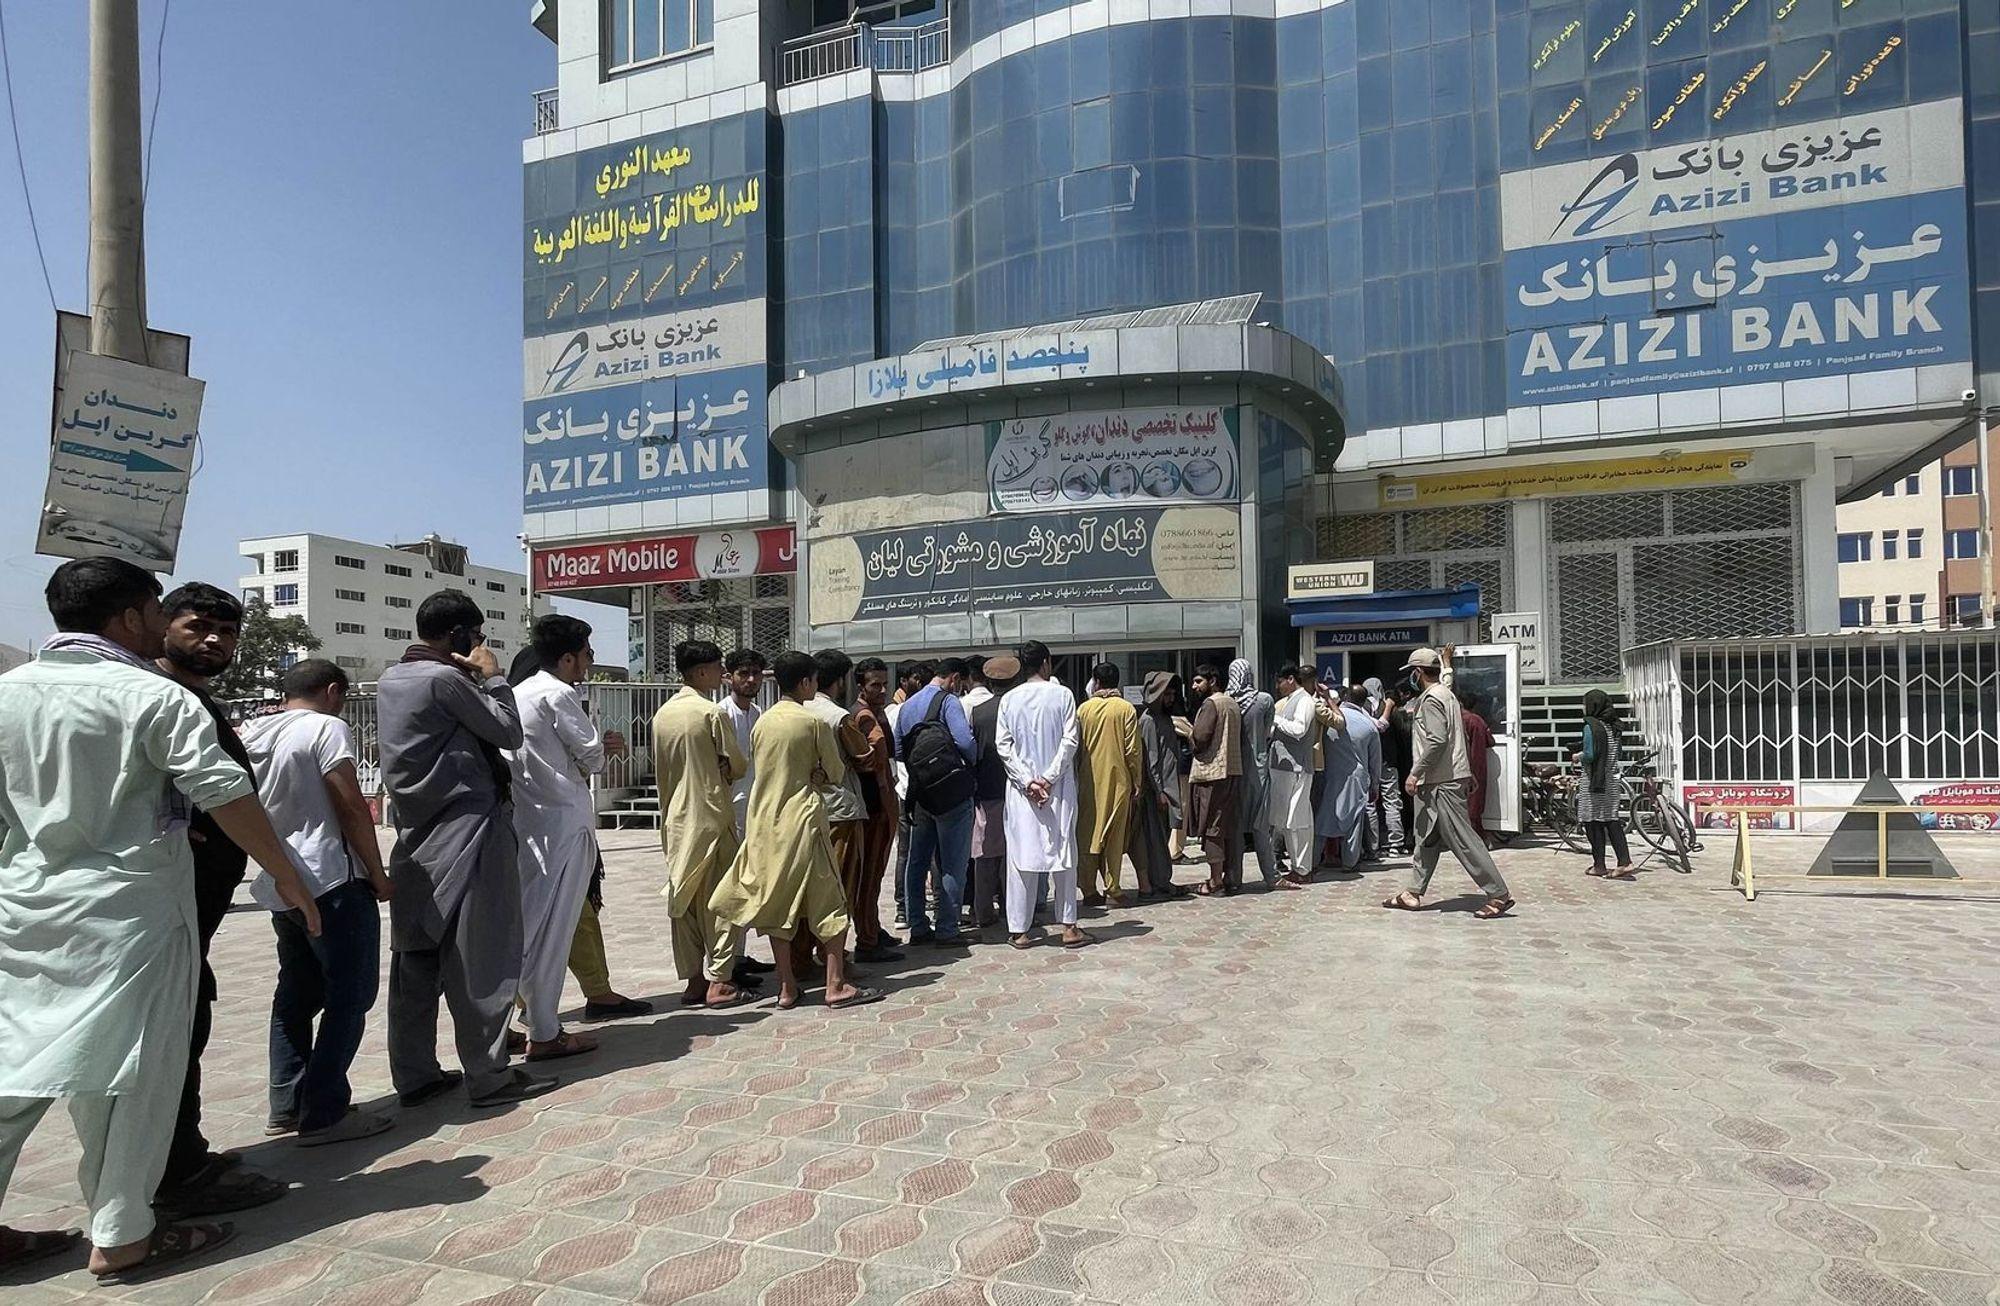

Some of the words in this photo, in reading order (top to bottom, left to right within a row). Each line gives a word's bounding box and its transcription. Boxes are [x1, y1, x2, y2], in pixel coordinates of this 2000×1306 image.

[1675, 72, 1706, 105] طبقات
[1651, 105, 1676, 130] صوت
[651, 144, 692, 176] معهد
[1651, 142, 1745, 183] بانک
[1760, 124, 1883, 175] عزیزی
[595, 143, 648, 199] النوري
[687, 176, 760, 228] للدراسات
[1648, 180, 1751, 218] Azizi
[1767, 163, 1889, 200] Bank
[533, 215, 583, 264] العربية
[584, 206, 628, 250] واللغة
[1693, 223, 1944, 301] عزیزی
[1517, 252, 1679, 308] بانک
[595, 326, 647, 353] بانک
[654, 317, 719, 349] عزیزی
[1520, 312, 1702, 378] AZIZI
[1731, 284, 1944, 355] BANK
[594, 354, 650, 379] Azizi
[658, 344, 722, 369] Bank
[916, 346, 998, 391] فامیلی
[1522, 380, 1600, 396] www.azizibank.af
[1746, 362, 1770, 373] 0797
[1826, 353, 1867, 365] Panjsad
[1869, 348, 1904, 361] Family
[1905, 344, 1944, 357] Branch
[83, 389, 178, 420] دندان
[616, 389, 750, 442] عزیزی
[62, 408, 110, 437] اپل
[523, 406, 609, 444] بانک
[1131, 413, 1176, 444] تخصصی
[524, 451, 622, 496] AZIZI
[638, 434, 750, 481] BANK
[1073, 452, 1085, 463] های
[1629, 468, 1654, 477] خدمات
[1655, 465, 1677, 475] شرکت
[1677, 465, 1694, 475] مجاز
[905, 530, 984, 576] مشورتی
[985, 541, 1001, 571] و
[1003, 517, 1098, 569] آموزشی
[547, 552, 601, 578] Maaz
[608, 544, 679, 574] Mobile
[866, 538, 904, 582] لیان
[1054, 587, 1082, 600] زبانهای
[1296, 575, 1337, 583] WESTERN
[1341, 573, 1364, 586] WU
[885, 601, 898, 612] های
[1005, 590, 1023, 603] علوم
[1332, 634, 1356, 643] AZIZI
[1358, 632, 1387, 642] BANK
[1389, 631, 1411, 641] ATM
[1498, 624, 1535, 638] ATM
[1323, 666, 1336, 681] A
[1717, 787, 1748, 799] موبایل
[1750, 787, 1791, 799] فروشگاه
[1942, 786, 1974, 797] موبایل
